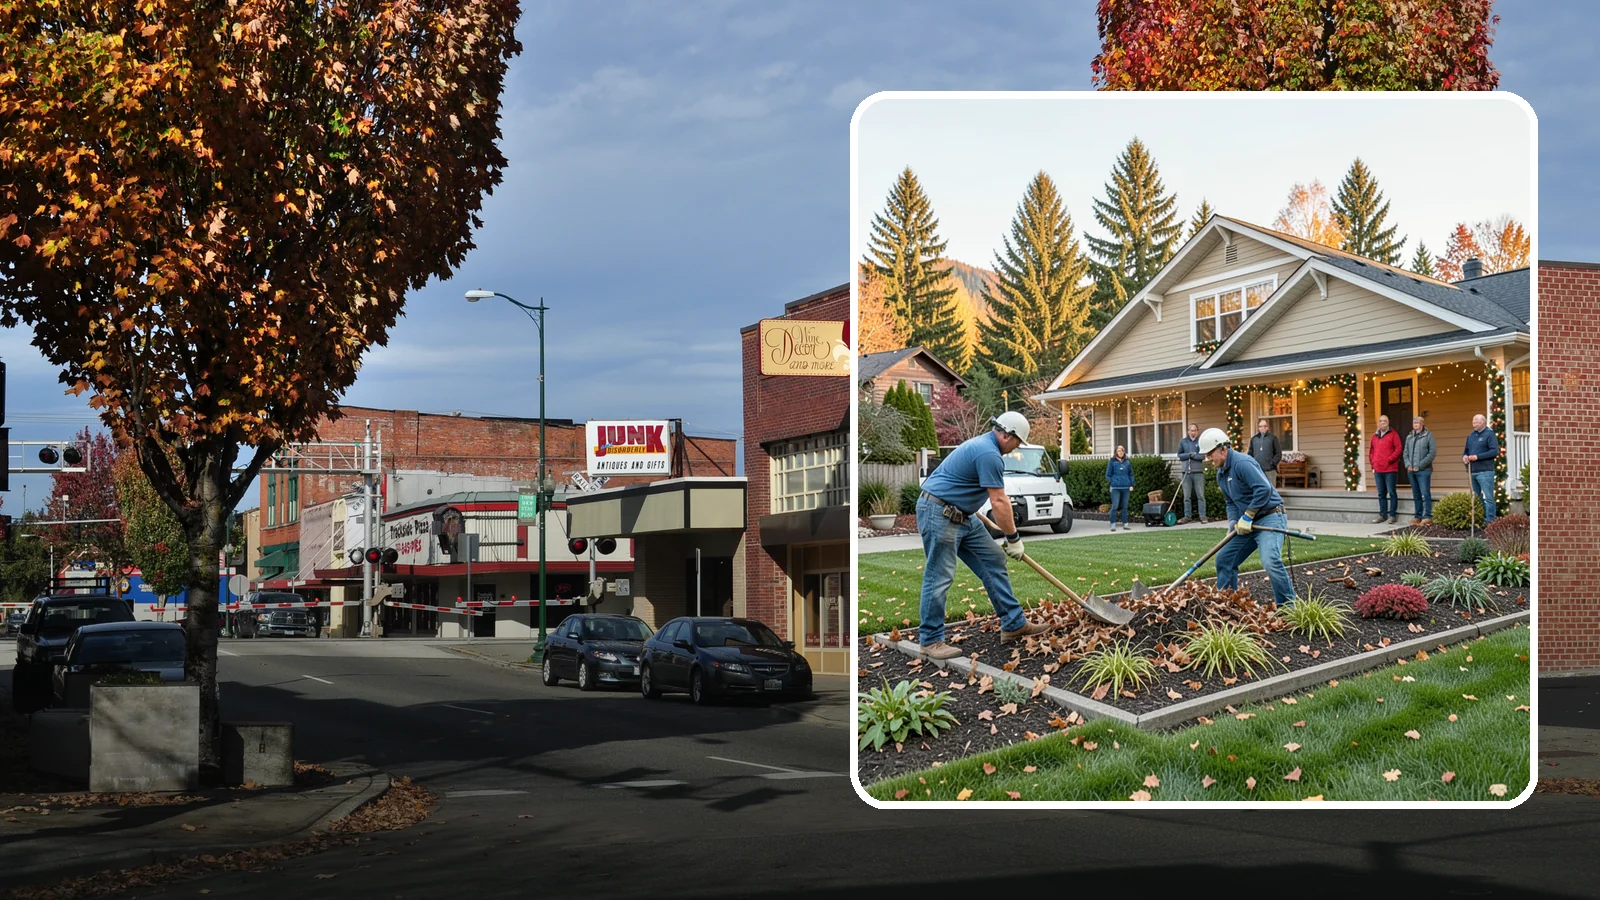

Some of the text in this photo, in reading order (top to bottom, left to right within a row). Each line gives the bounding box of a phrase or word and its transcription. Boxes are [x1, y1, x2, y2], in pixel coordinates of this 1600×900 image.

[596, 425, 664, 457] JUNK
[607, 446, 646, 454] DISORDERLY
[597, 460, 665, 470] ANTIQUES AND GIFTS
[414, 519, 429, 535] Pizza
